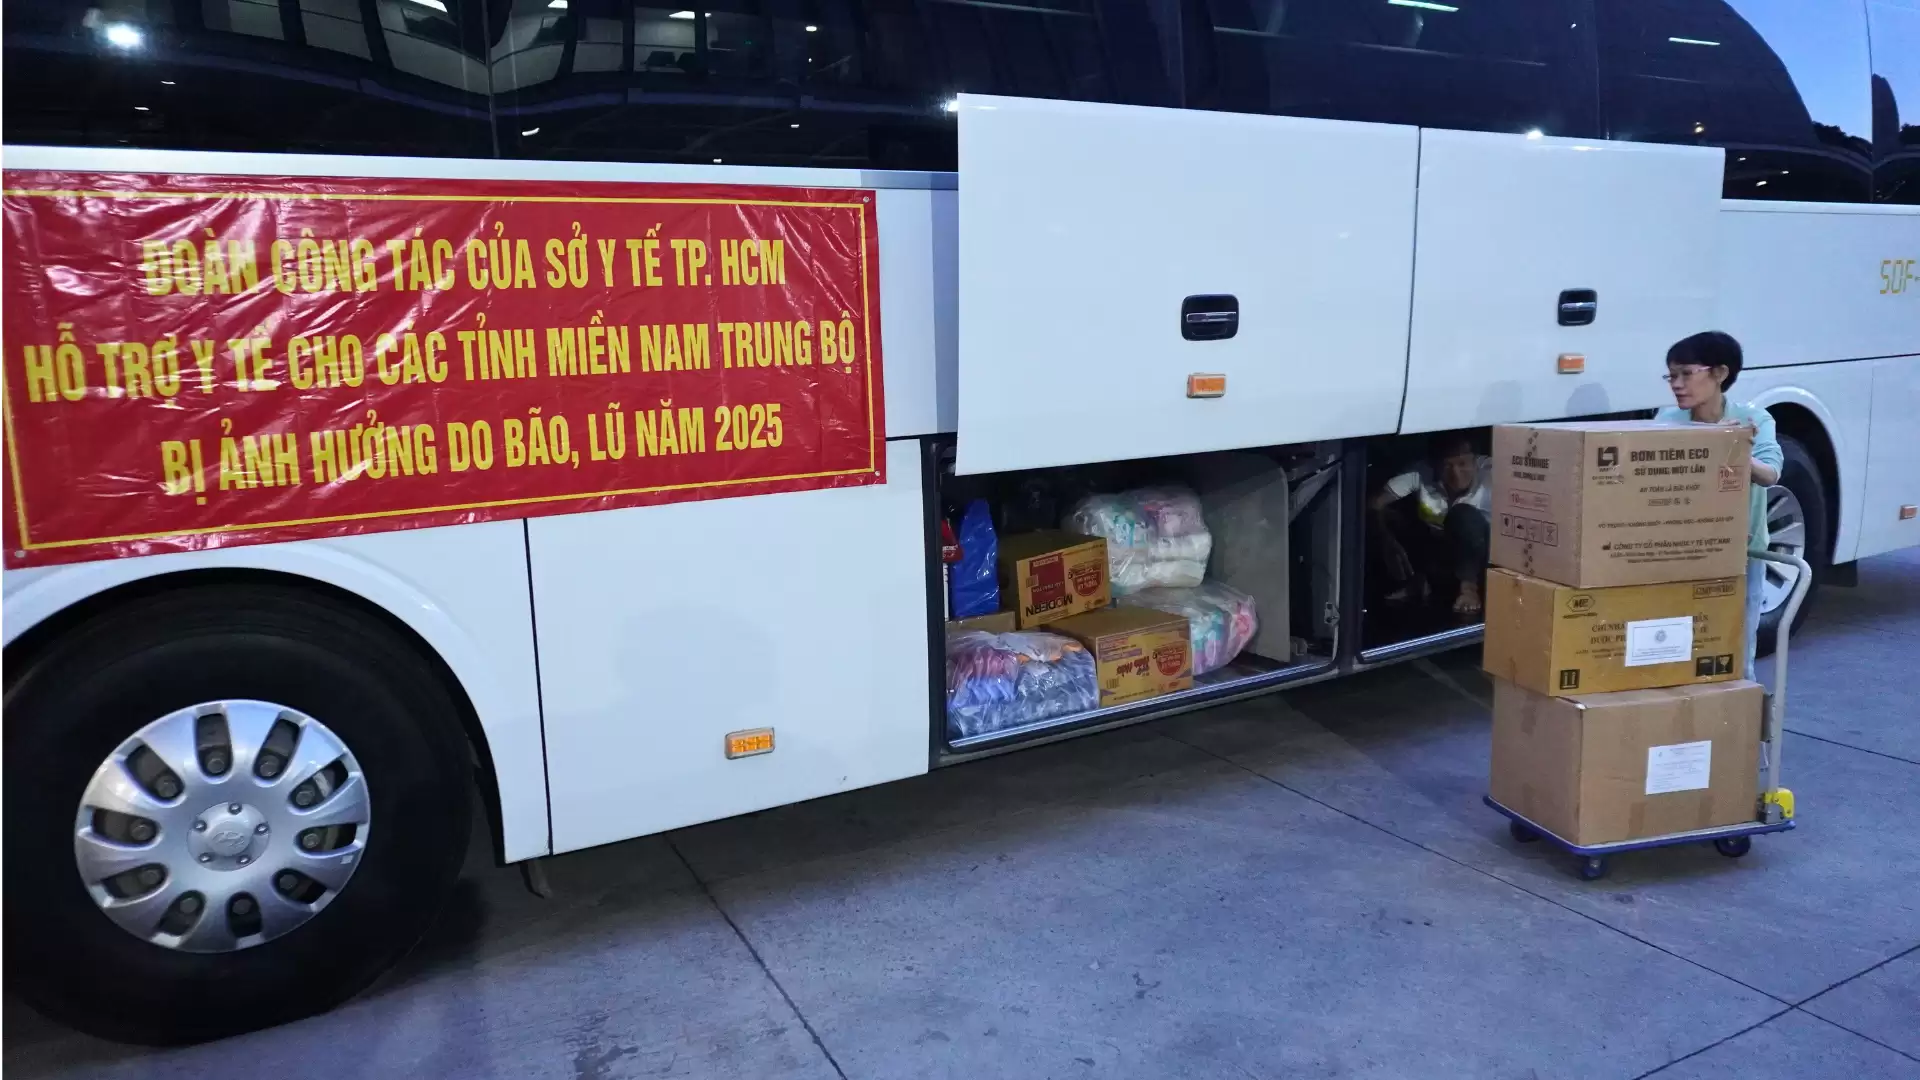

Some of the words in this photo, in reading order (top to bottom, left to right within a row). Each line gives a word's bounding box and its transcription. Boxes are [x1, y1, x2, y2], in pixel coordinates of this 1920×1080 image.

[142, 228, 260, 296] ĐOÀN
[271, 229, 377, 295] CÔNG
[386, 228, 455, 291] TÁC
[467, 221, 536, 290] CỦA
[545, 221, 588, 289] SỞ
[597, 238, 618, 288] Y
[626, 223, 663, 288] TẾ
[670, 239, 712, 286] TP.
[720, 238, 786, 286] HCM
[23, 323, 87, 403] HỖ
[96, 335, 183, 407] TRỢ
[190, 340, 217, 394] Y
[228, 320, 280, 392] TẾ
[288, 334, 366, 390] CHO
[375, 321, 448, 386] CÁC
[458, 312, 536, 382] TỈNH
[547, 310, 630, 376] MIỀN
[640, 323, 711, 373] NAM
[718, 321, 812, 369] TRUNG
[820, 310, 856, 374] BỘ
[162, 439, 206, 505] BỊ
[219, 418, 300, 491] ẢNH
[310, 409, 438, 484] HƯỞNG
[448, 415, 494, 473] DO
[504, 407, 580, 469] BÃO,
[587, 402, 626, 461] LŨ
[635, 399, 706, 457] NĂM
[715, 403, 784, 452] 2025
[1689, 448, 1710, 460] ECO
[1026, 594, 1073, 617] MODERN
